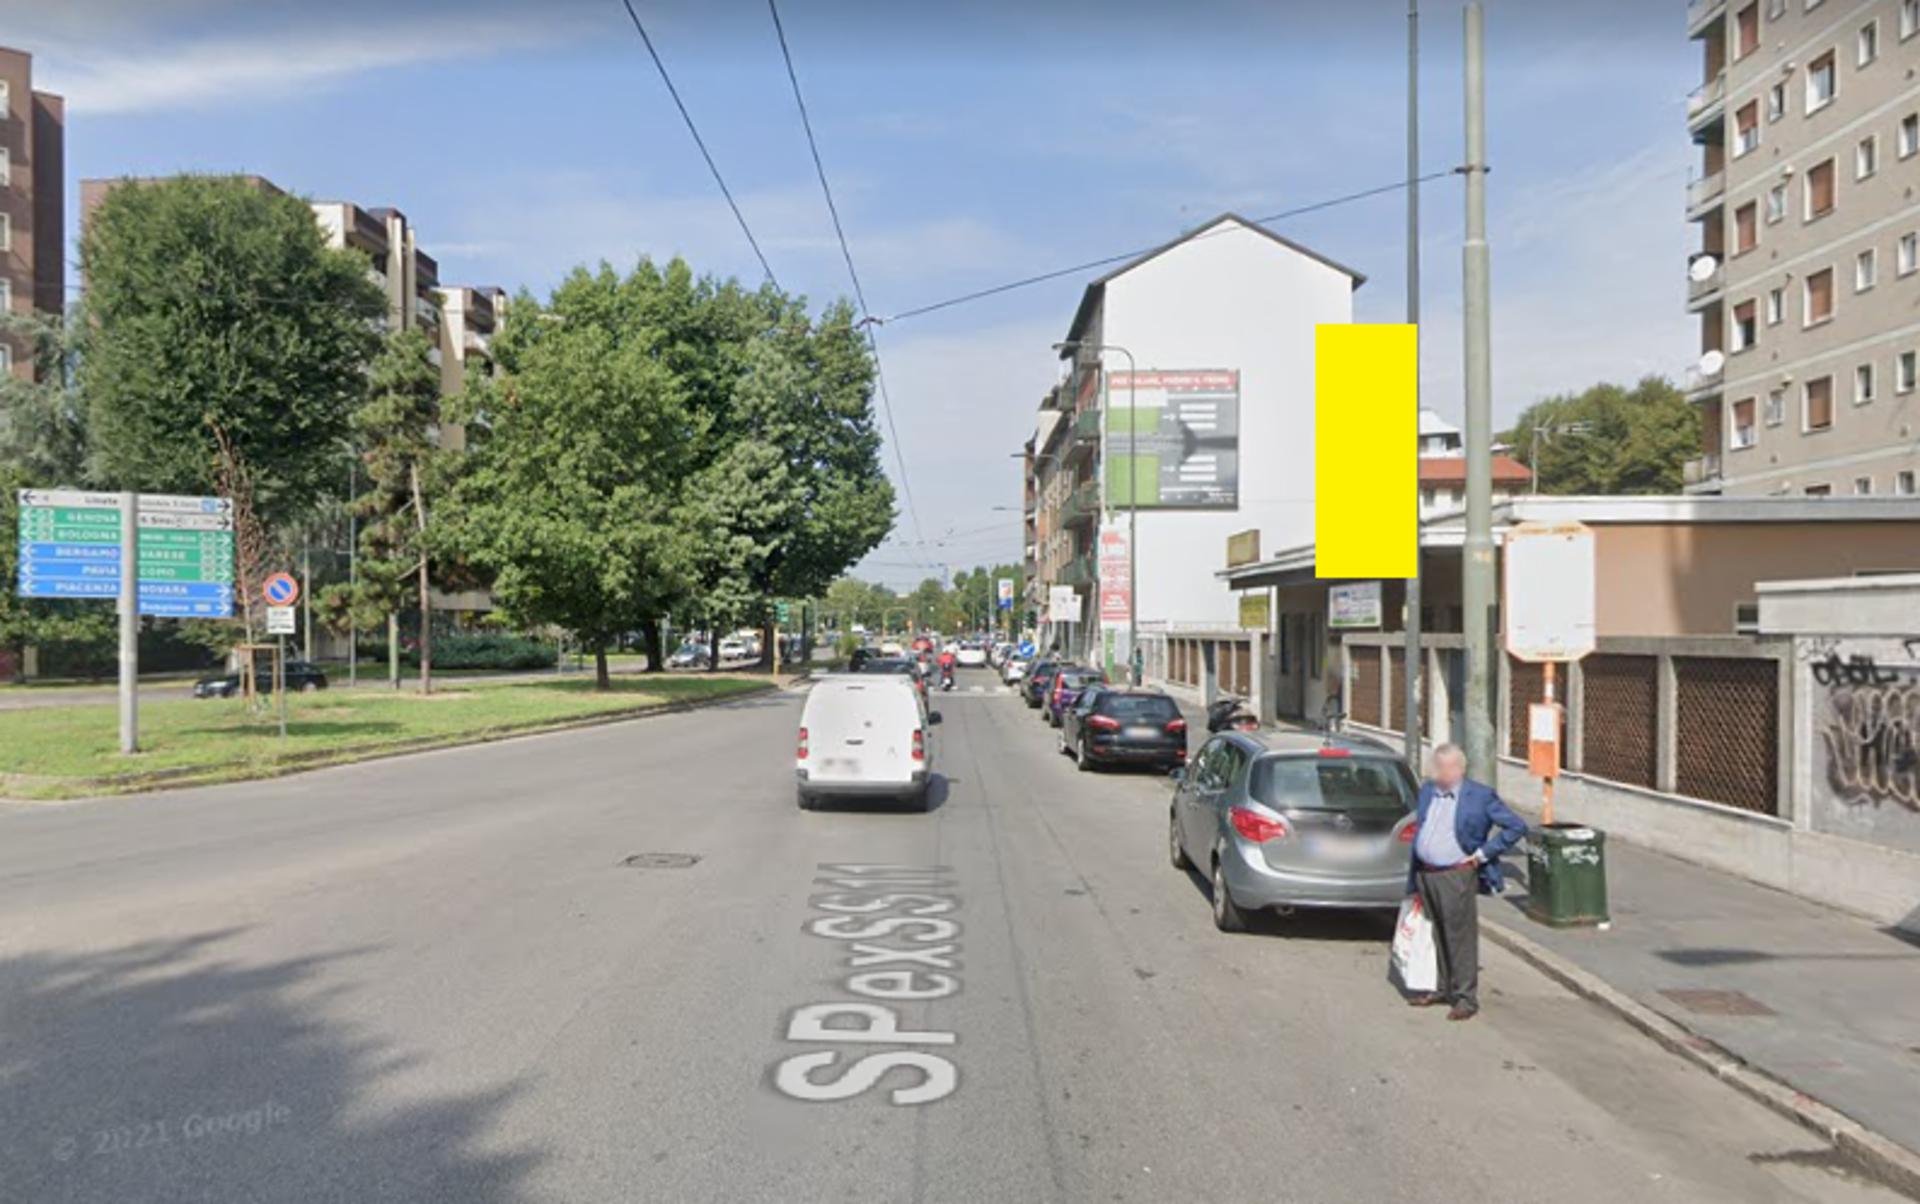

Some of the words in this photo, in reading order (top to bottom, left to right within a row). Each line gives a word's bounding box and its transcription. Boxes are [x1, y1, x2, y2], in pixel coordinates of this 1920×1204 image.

[68, 512, 117, 521] GENOVA
[58, 530, 117, 539] BOLOGNA
[54, 548, 119, 558] BERGAMO
[82, 565, 117, 574] PAVIA
[139, 567, 176, 577] COMO
[55, 583, 117, 592] PIACENZA
[139, 584, 189, 594] NOVARA
